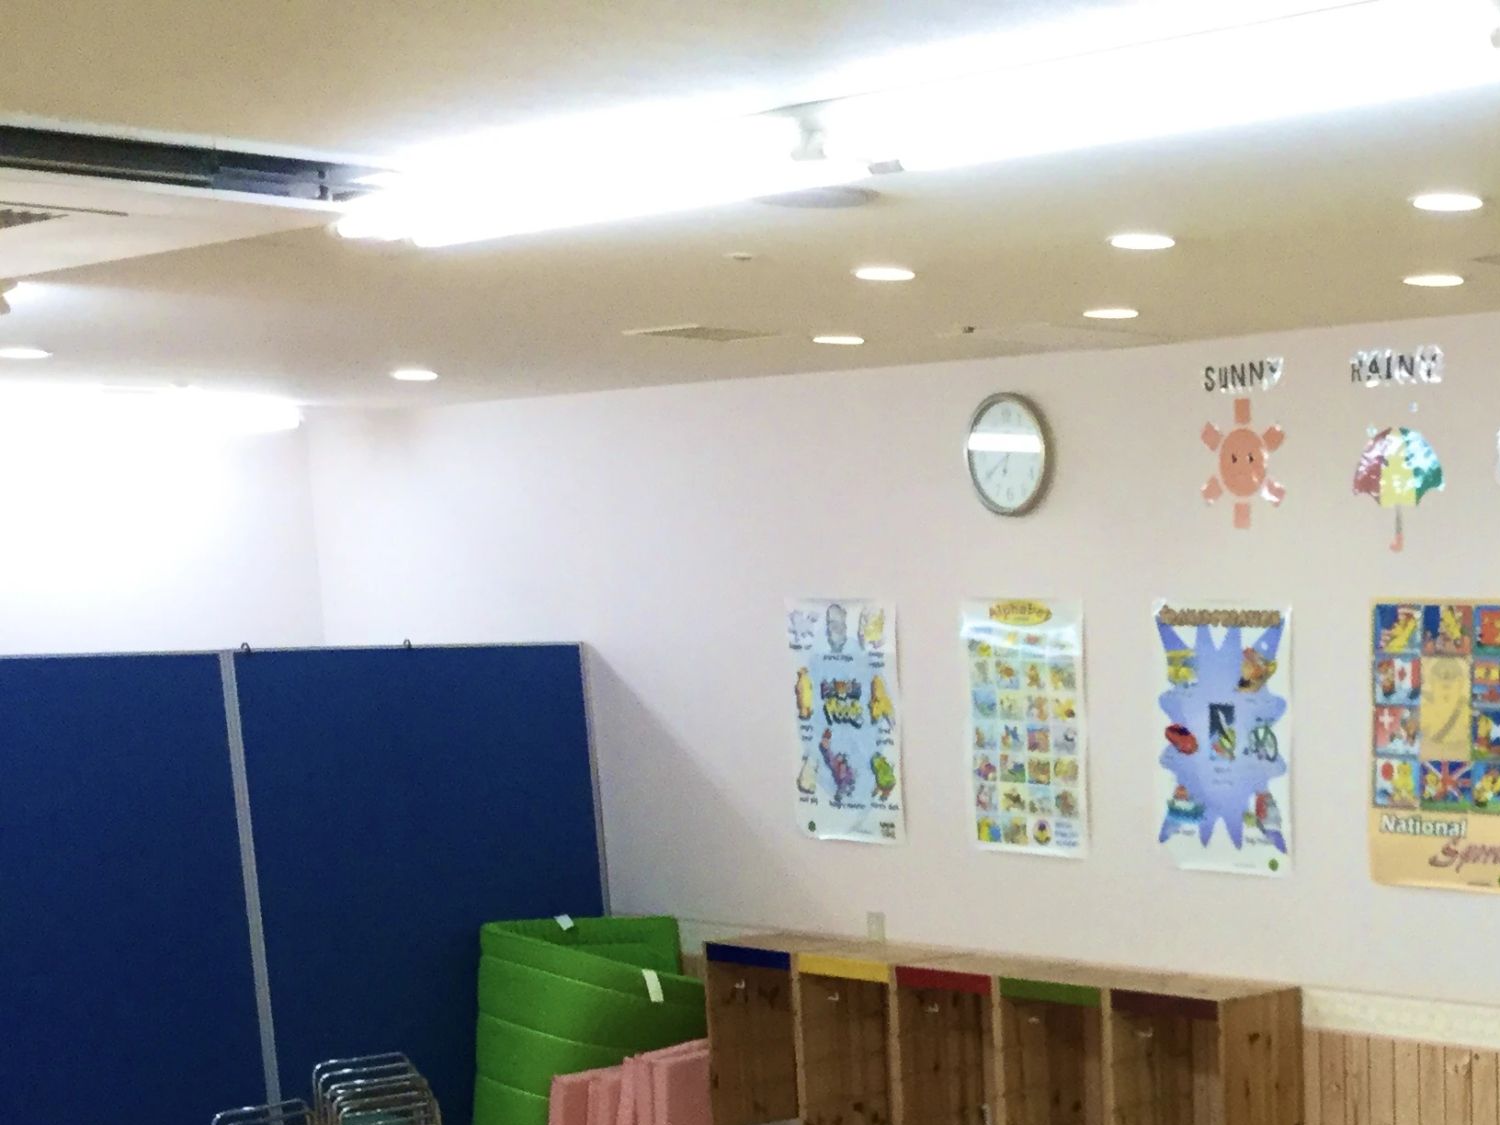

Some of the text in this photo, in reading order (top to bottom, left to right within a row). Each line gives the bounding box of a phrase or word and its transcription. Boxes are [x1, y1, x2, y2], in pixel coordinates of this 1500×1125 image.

[1203, 358, 1284, 392] SUNNY
[1350, 350, 1439, 382] RAINY
[1380, 813, 1467, 838] National
